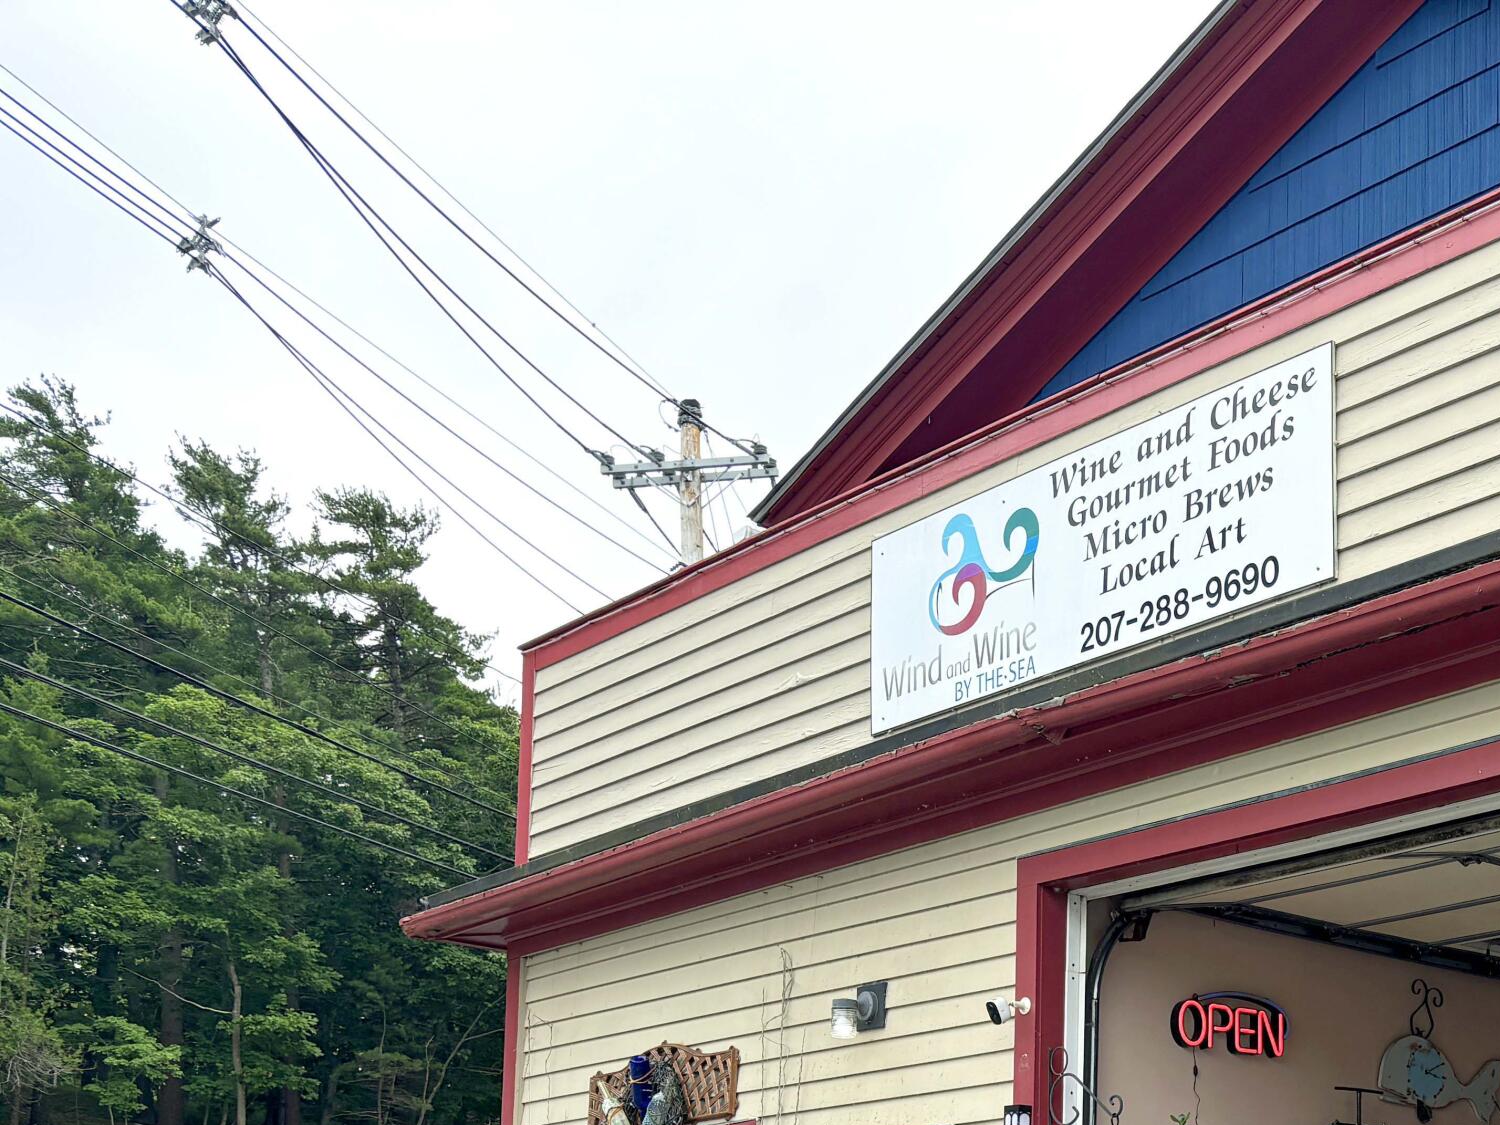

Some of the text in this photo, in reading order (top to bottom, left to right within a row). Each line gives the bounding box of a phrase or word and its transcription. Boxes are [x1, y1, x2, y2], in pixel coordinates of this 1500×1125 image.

[1049, 366, 1318, 500] Wine and Cheese
[1066, 409, 1296, 528] Gourmet Foods
[1082, 464, 1275, 562] Micro Brews
[1098, 515, 1249, 596] Local Art
[1080, 554, 1280, 654] 207-288-9690
[880, 619, 1039, 702] Wind and Wine
[953, 676, 974, 702] BY
[1178, 999, 1285, 1057] OPEN
